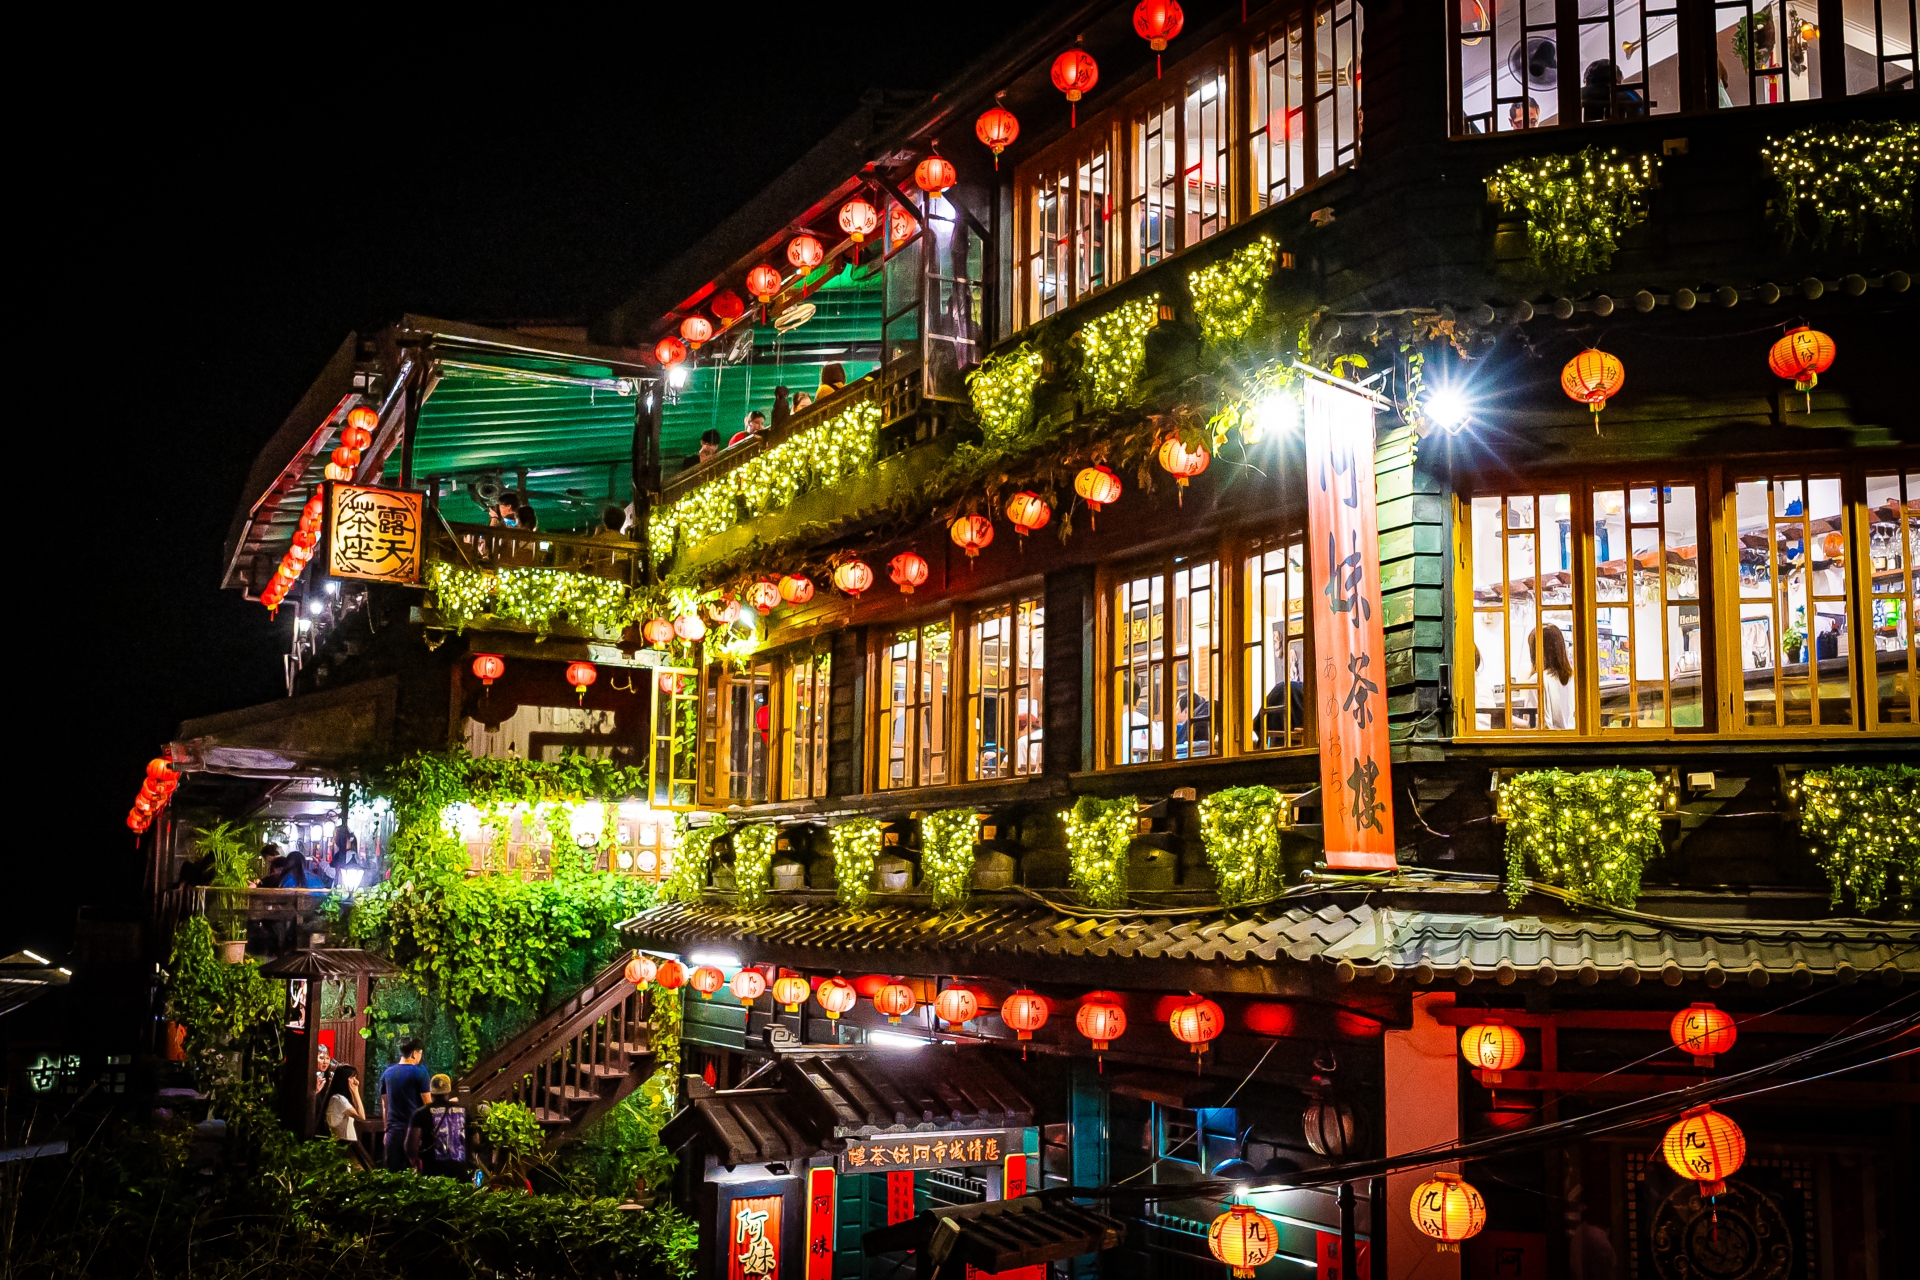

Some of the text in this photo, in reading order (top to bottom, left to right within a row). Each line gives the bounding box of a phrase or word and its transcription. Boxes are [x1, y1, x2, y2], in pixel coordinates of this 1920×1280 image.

[1797, 334, 1815, 363] 九份
[1680, 614, 1700, 625] Hein
[1322, 654, 1348, 823] あめおちゃ
[1108, 1009, 1119, 1037] 九份
[1199, 1010, 1213, 1039] 九份
[1683, 1015, 1701, 1050] 九份
[1483, 1031, 1496, 1065] 九份
[1684, 1131, 1712, 1174] 九份
[1421, 1190, 1444, 1237] 九份
[737, 1207, 777, 1280] 阿妹
[1248, 1221, 1267, 1265] 九份
